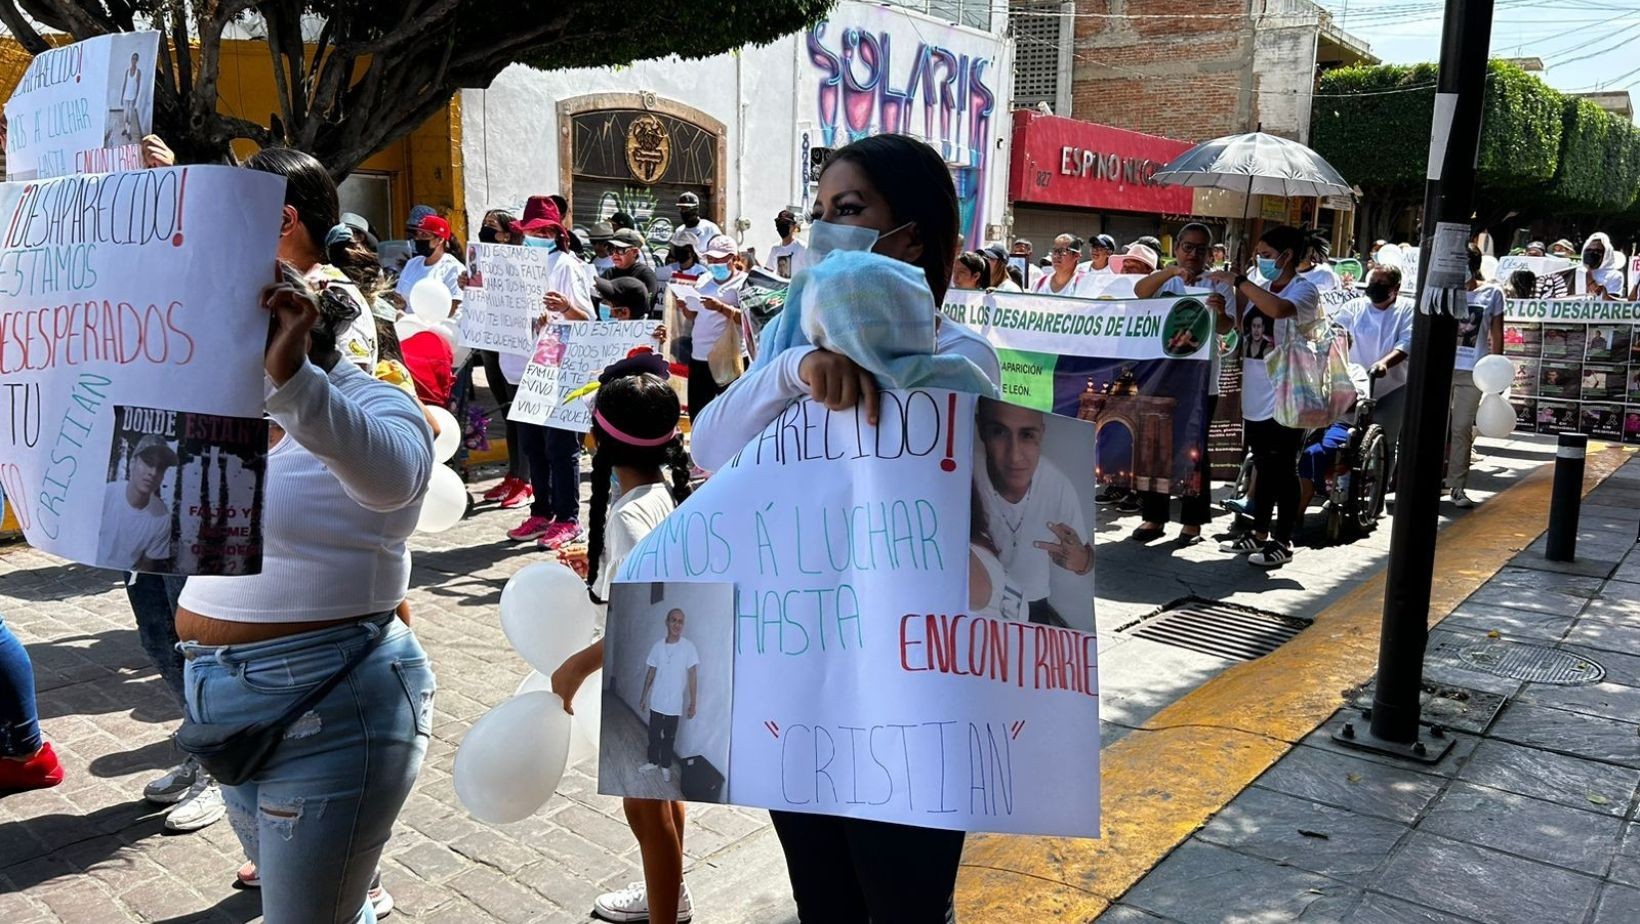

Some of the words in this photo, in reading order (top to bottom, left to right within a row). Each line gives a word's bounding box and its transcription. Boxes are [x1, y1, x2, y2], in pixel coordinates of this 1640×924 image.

[807, 19, 995, 118] SOLARIS
[1035, 170, 1052, 187] 827
[5, 168, 188, 248] ¡DESAPARECIDO!
[493, 246, 539, 262] ESTAMOS
[0, 244, 98, 297] ESTAMOS
[970, 305, 990, 326] LOS
[992, 308, 1103, 336] DESAPARECIDOS
[1104, 316, 1125, 336] DE
[1125, 310, 1162, 337] LEÓN
[1518, 301, 1547, 318] LOS
[0, 300, 195, 375] ESESPERADOS
[571, 322, 588, 337] NO
[591, 321, 655, 338] ESTAMOS
[567, 342, 599, 358] TODOS
[602, 344, 620, 358] NOS
[573, 373, 586, 385] TE
[1001, 361, 1043, 375] APARICIÓN
[1002, 383, 1008, 393] E
[3, 382, 41, 448] TU
[122, 405, 177, 437] DONDE
[731, 390, 957, 473] ARECIDO!
[795, 499, 944, 574] LUCHAR
[736, 583, 863, 656] HASTA
[899, 613, 1099, 697] ENCONTRARTE
